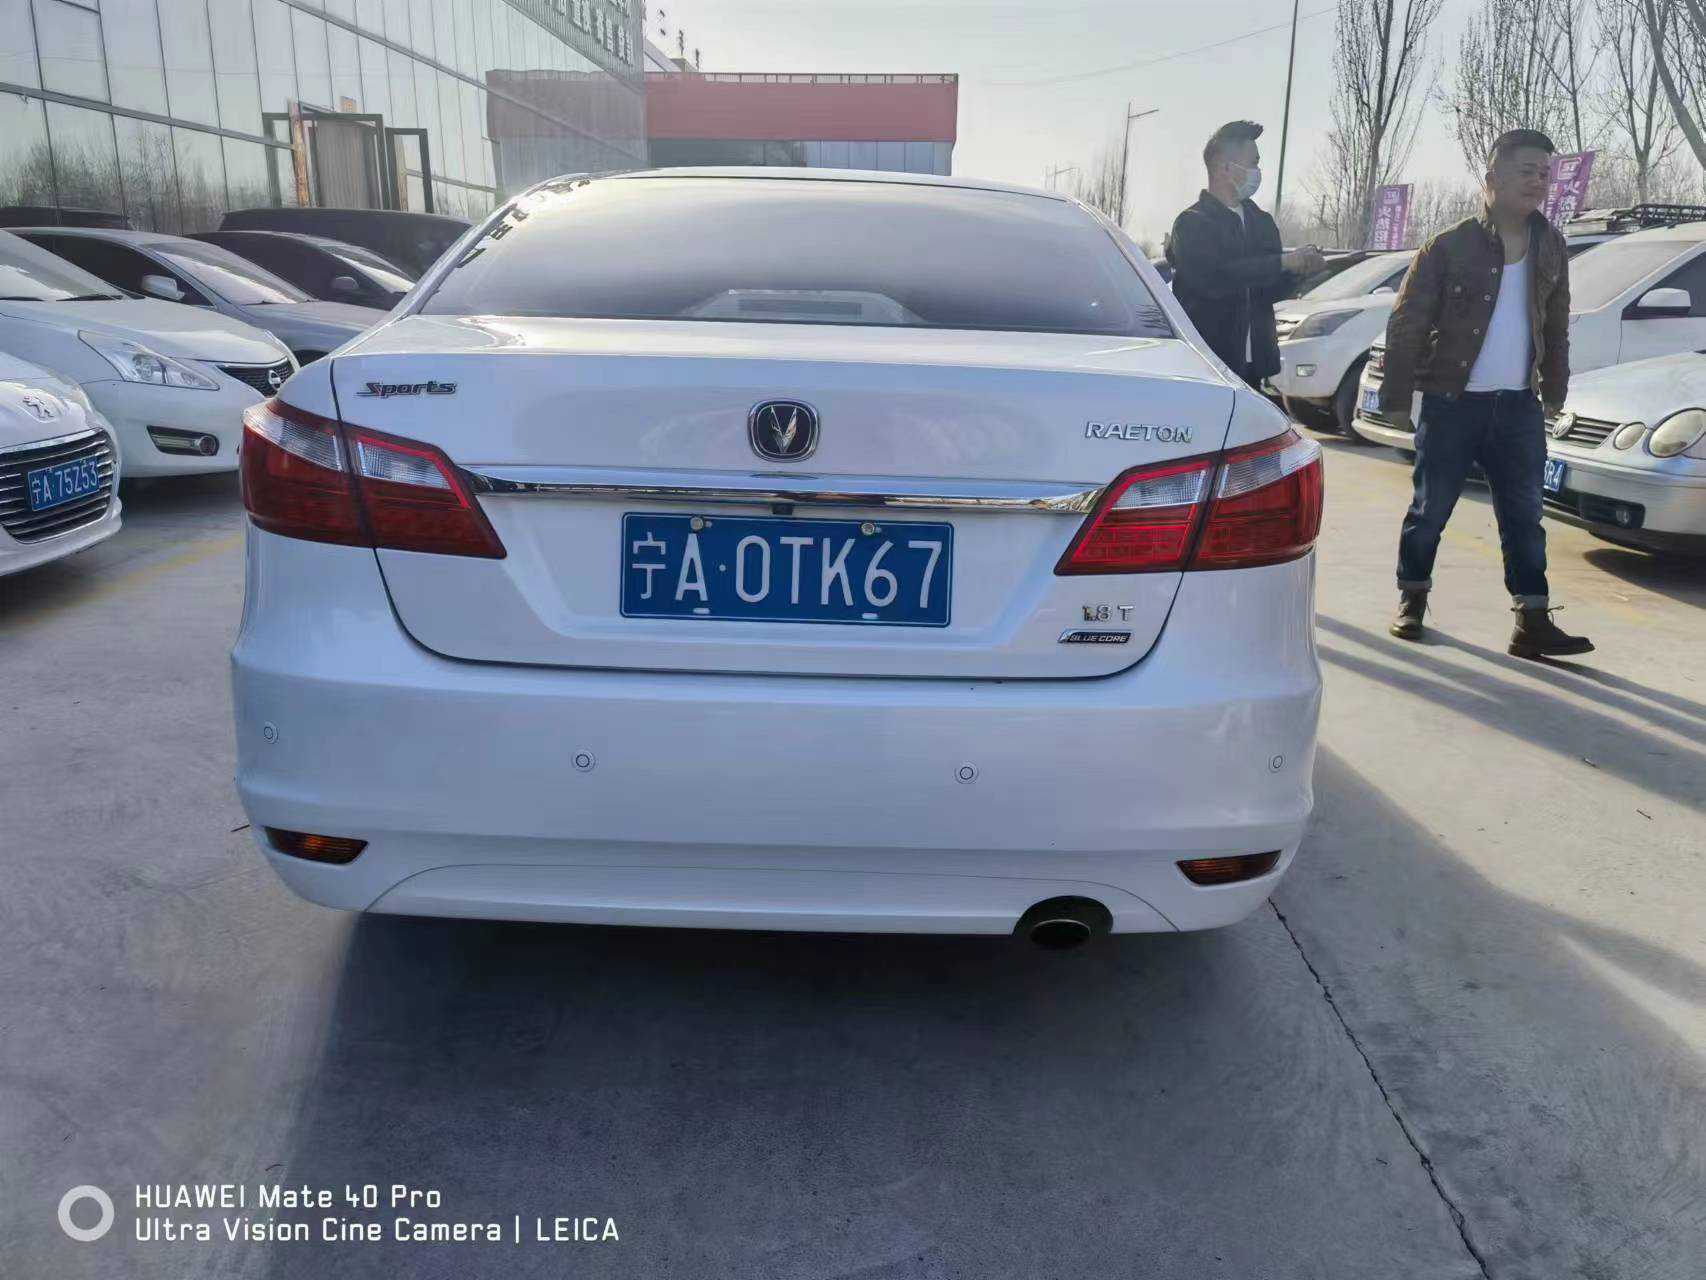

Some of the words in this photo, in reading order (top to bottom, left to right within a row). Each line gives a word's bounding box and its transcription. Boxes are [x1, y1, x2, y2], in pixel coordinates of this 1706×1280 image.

[356, 381, 457, 398] Sports
[1085, 421, 1193, 443] RAETON
[1117, 605, 1135, 621] T
[1098, 634, 1128, 642] CORE
